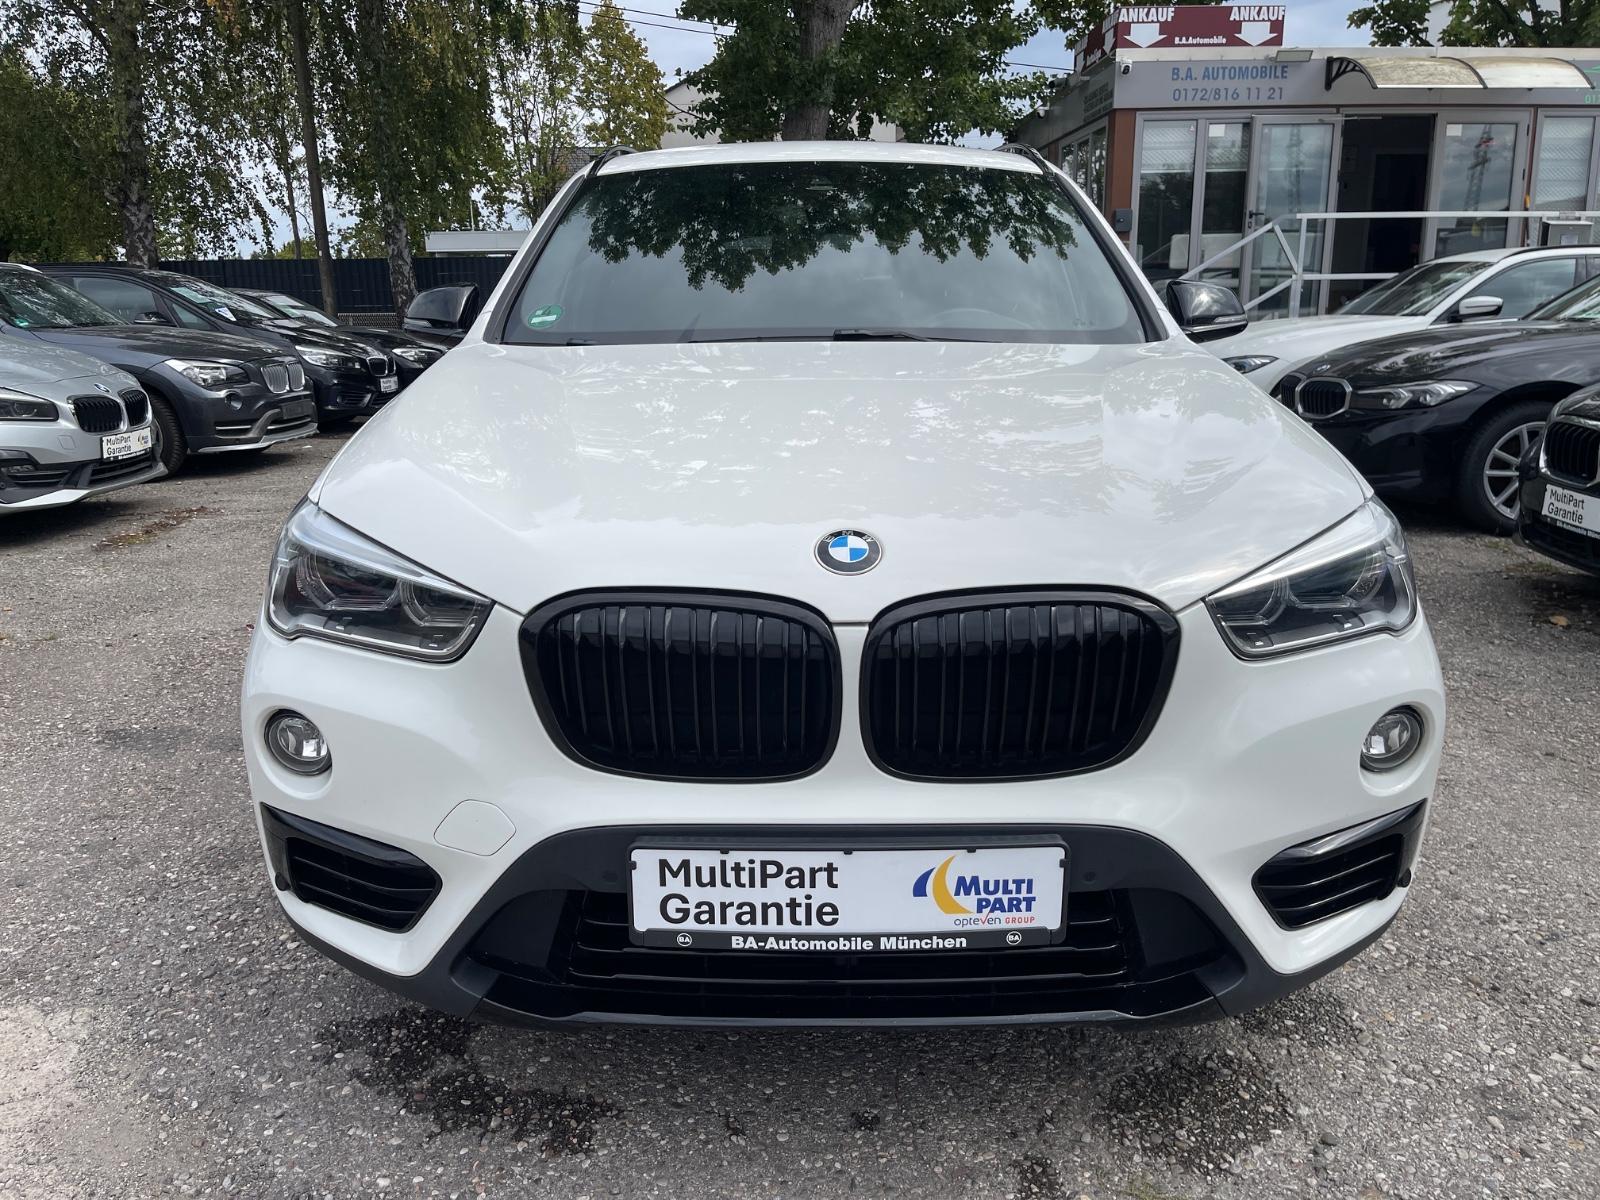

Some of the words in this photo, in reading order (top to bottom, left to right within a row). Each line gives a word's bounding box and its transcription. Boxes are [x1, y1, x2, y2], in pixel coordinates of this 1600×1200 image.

[1118, 7, 1175, 23] ANKAUF
[1229, 6, 1285, 21] ANKAUF
[1171, 66, 1198, 81] B.A.
[1202, 64, 1289, 81] AUTOMOBILE
[1172, 87, 1240, 101] 0172/816
[1246, 87, 1261, 101] 11
[1266, 86, 1284, 101] 21
[1550, 488, 1584, 510] MultiPart
[1547, 502, 1583, 524] Garantie
[658, 858, 839, 889] MultiPart
[659, 892, 840, 927] Garantie
[976, 896, 1037, 914] PART
[1004, 916, 1036, 924] GROUP
[731, 935, 874, 951] BA-Automobile
[880, 935, 968, 950] München
